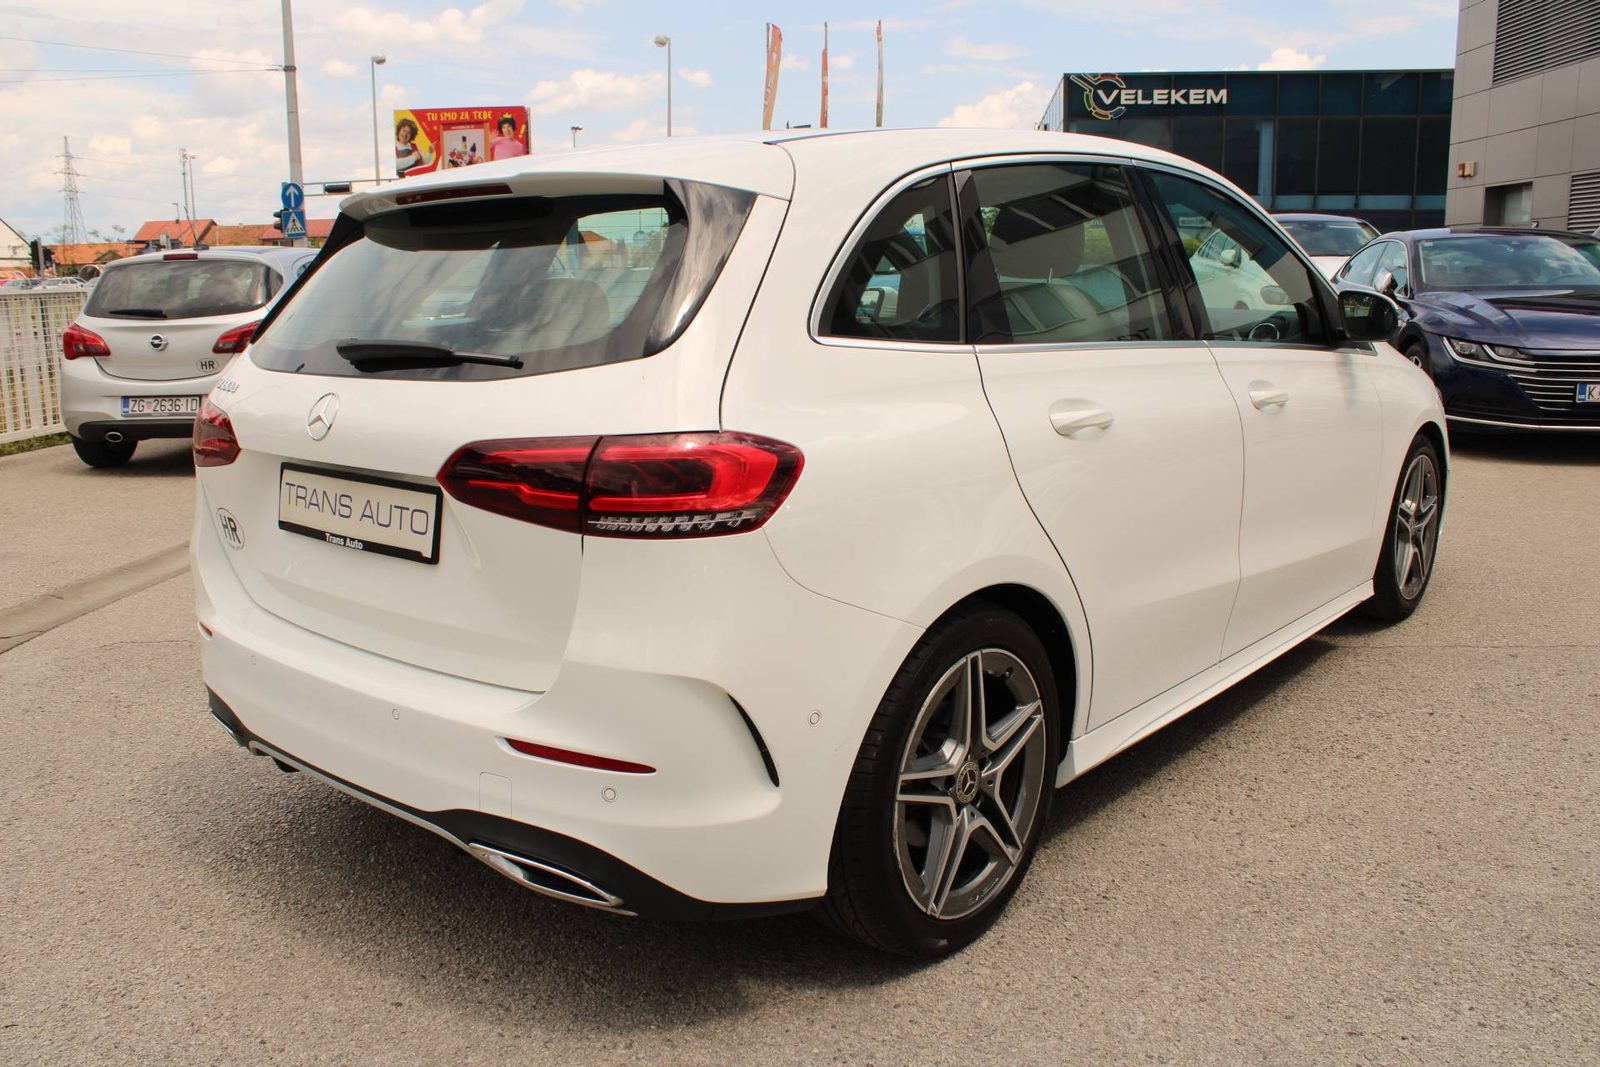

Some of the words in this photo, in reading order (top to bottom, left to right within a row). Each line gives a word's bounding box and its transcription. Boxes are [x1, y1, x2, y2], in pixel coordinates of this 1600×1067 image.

[1096, 88, 1228, 105] VELEKEM
[426, 111, 438, 121] TU
[440, 111, 457, 121] SMO
[460, 110, 470, 120] ZA
[473, 110, 493, 120] TEBE
[200, 360, 215, 370] HR
[130, 399, 145, 412] ZG
[285, 482, 353, 519] TRANS
[359, 499, 430, 536] AUTO
[219, 513, 241, 544] HR
[325, 532, 345, 545] Trans
[346, 537, 363, 550] Auto
